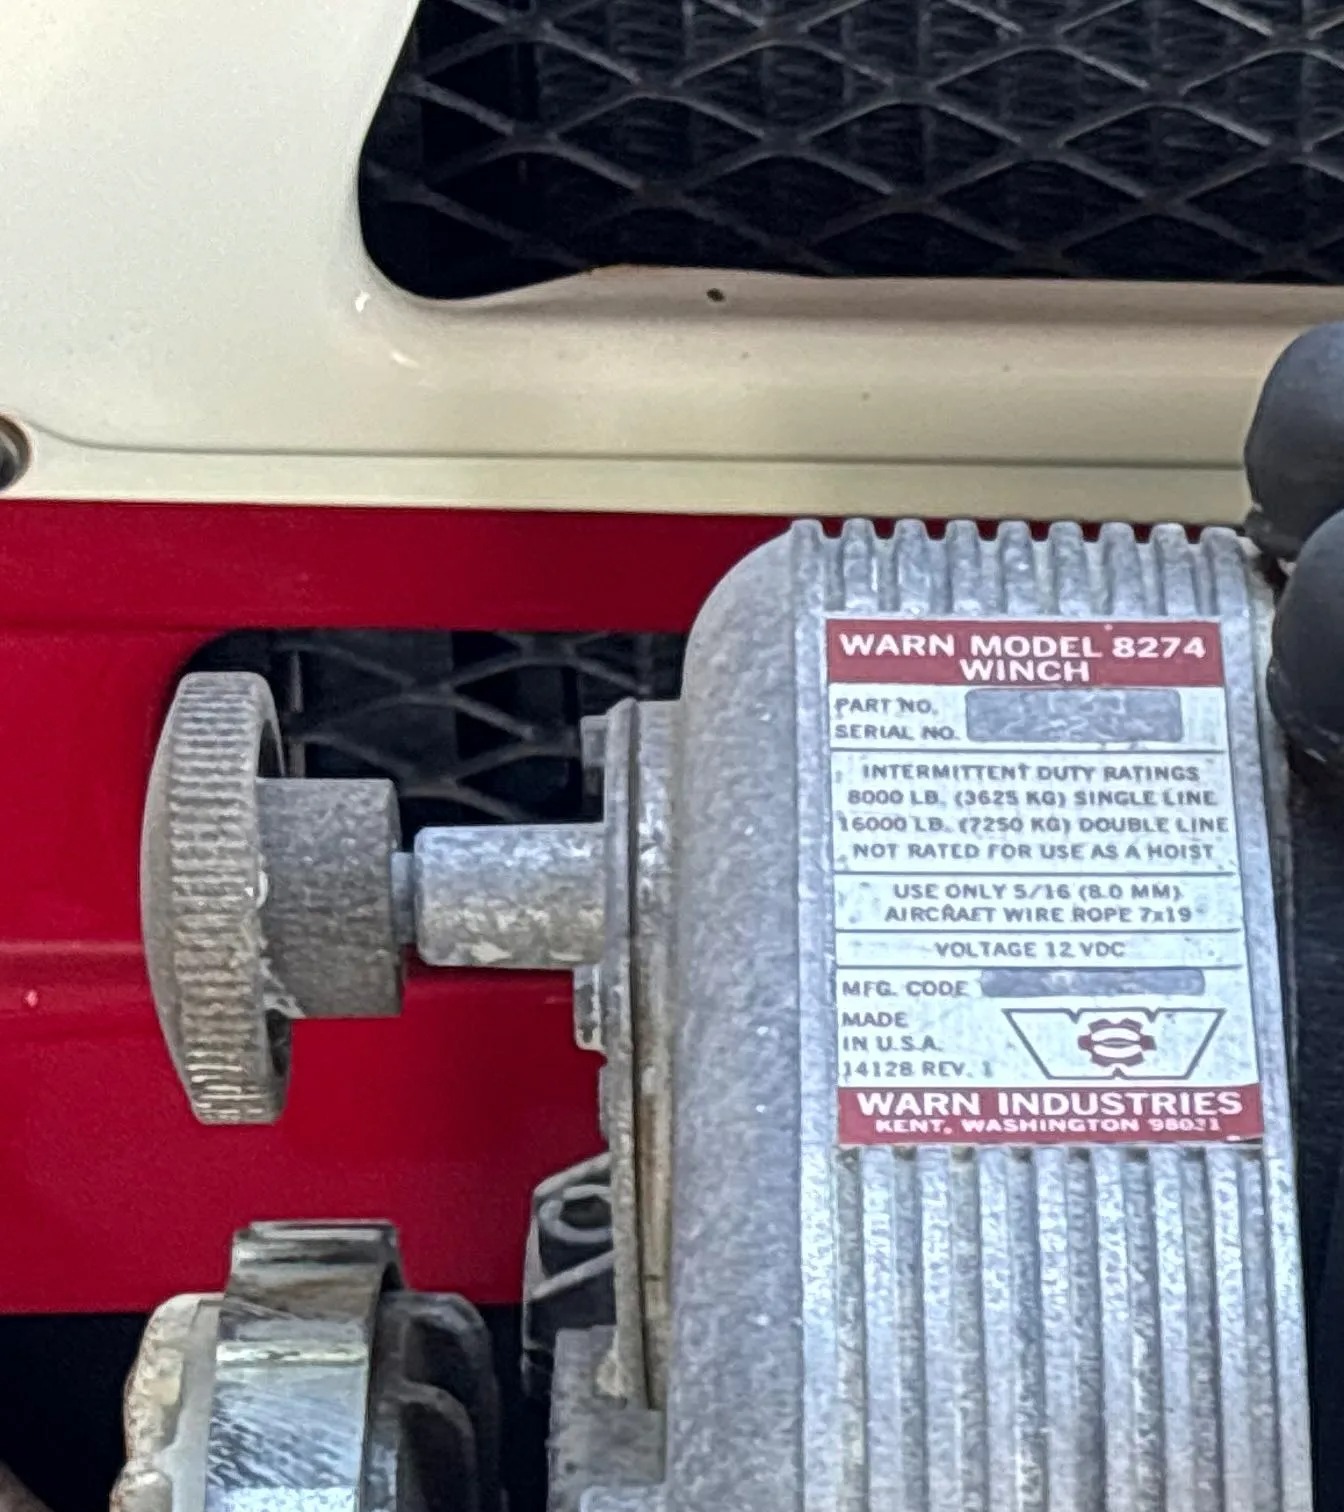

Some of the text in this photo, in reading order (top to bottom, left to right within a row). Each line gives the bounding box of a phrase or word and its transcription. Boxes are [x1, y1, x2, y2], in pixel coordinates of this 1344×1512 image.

[839, 633, 1207, 659] WARN MODEL 8274
[959, 659, 1091, 683] WINCH
[834, 697, 939, 716] PART NO.
[834, 723, 962, 742] SERIAL NO.
[862, 763, 1200, 783] INTERMITTENT DUTY RATINGS
[847, 789, 1219, 807] 8000 LB. (3625 KG) SINGLE LINE
[839, 814, 1229, 834] 16000 LB. (7250 KG) DOUBLE LINE
[853, 843, 1214, 861] NOT RATED FOR USE AS A HOIST
[893, 883, 938, 900] USE
[945, 883, 1007, 900] ONLY
[1013, 883, 1071, 901] 5/16
[1078, 883, 1123, 902] (8.0
[884, 905, 997, 923] AIRCRAFT
[1003, 906, 1065, 923] WIRE
[1072, 906, 1132, 923] ROPE
[934, 941, 1127, 958] VOLTAGE 12 VDC
[841, 980, 970, 997] MFG. CODE
[841, 1011, 909, 1028] MADE
[842, 1035, 868, 1051] IN
[842, 1060, 914, 1078] 14128
[921, 1060, 974, 1078] REV.
[856, 1090, 1244, 1117] WARN INDUSTRIES
[960, 1117, 1141, 1134] WASHINGTON
